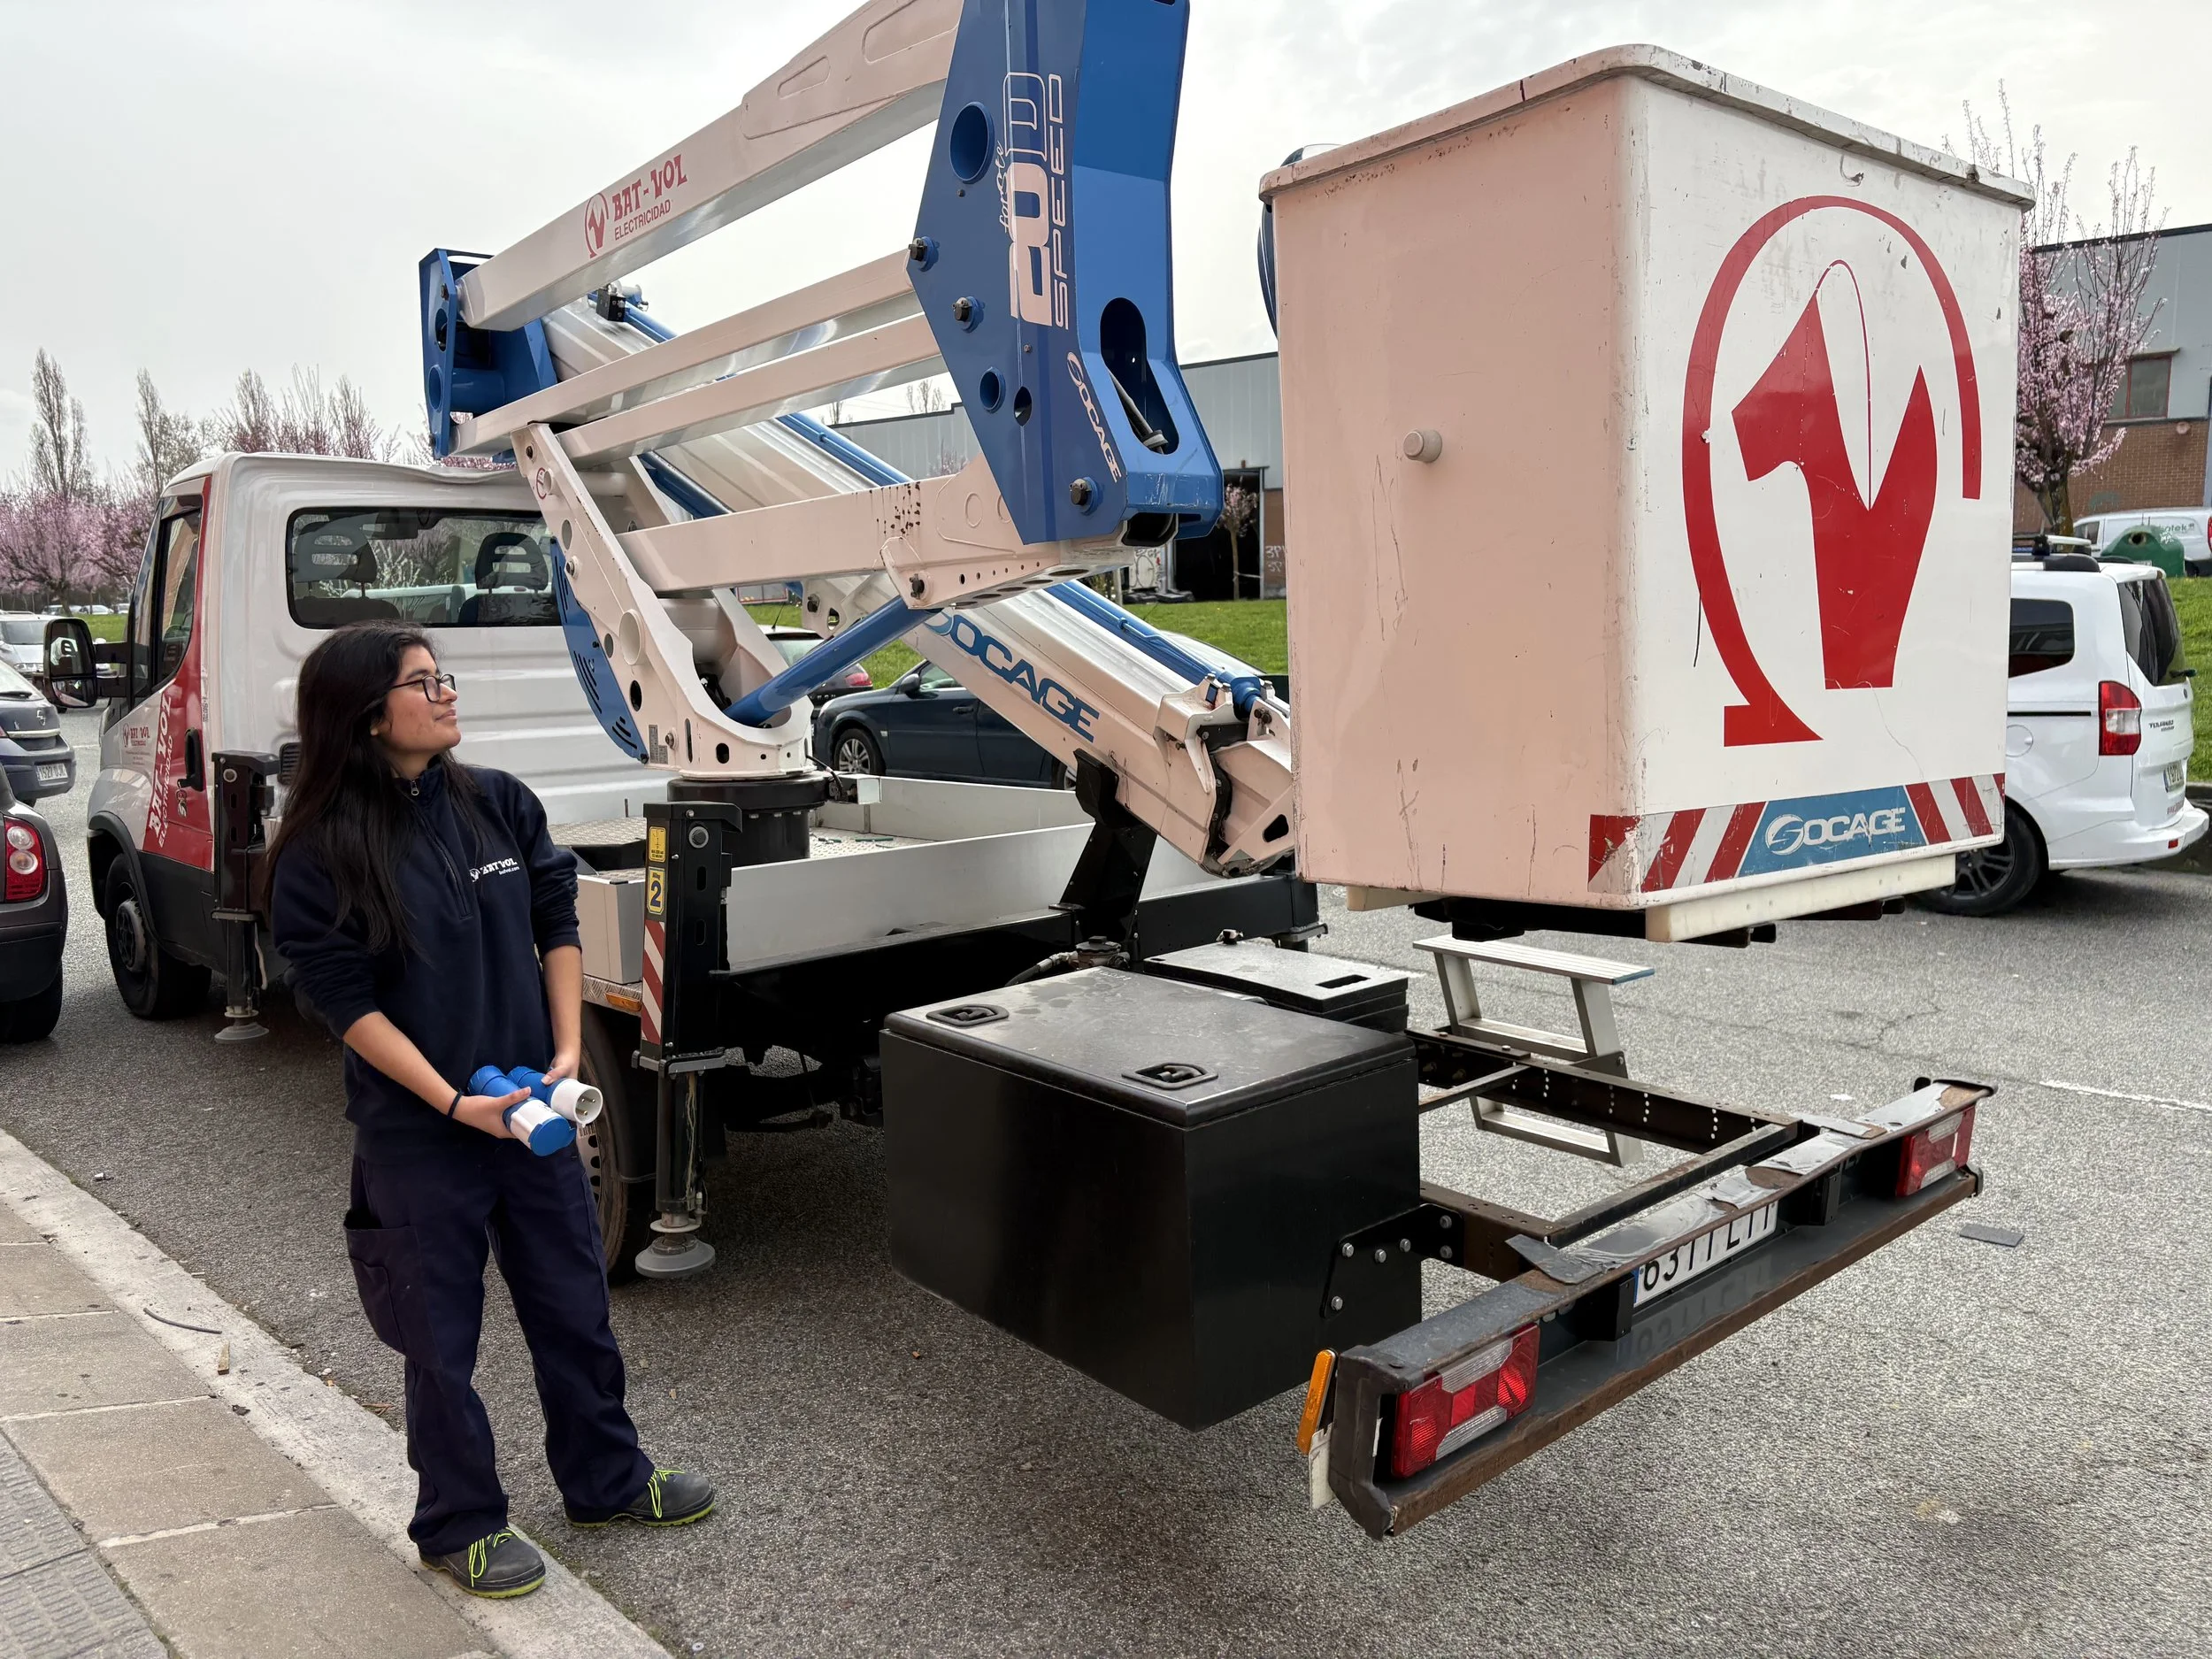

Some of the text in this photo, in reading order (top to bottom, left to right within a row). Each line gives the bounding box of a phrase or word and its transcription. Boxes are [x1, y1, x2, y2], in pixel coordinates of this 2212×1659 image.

[615, 199, 671, 241] ELECTRICIDAD
[1048, 73, 1069, 330] SPEED
[1067, 352, 1122, 483] SOCAGE
[1765, 806, 1906, 856] SOCAGE
[650, 880, 661, 907] 2
